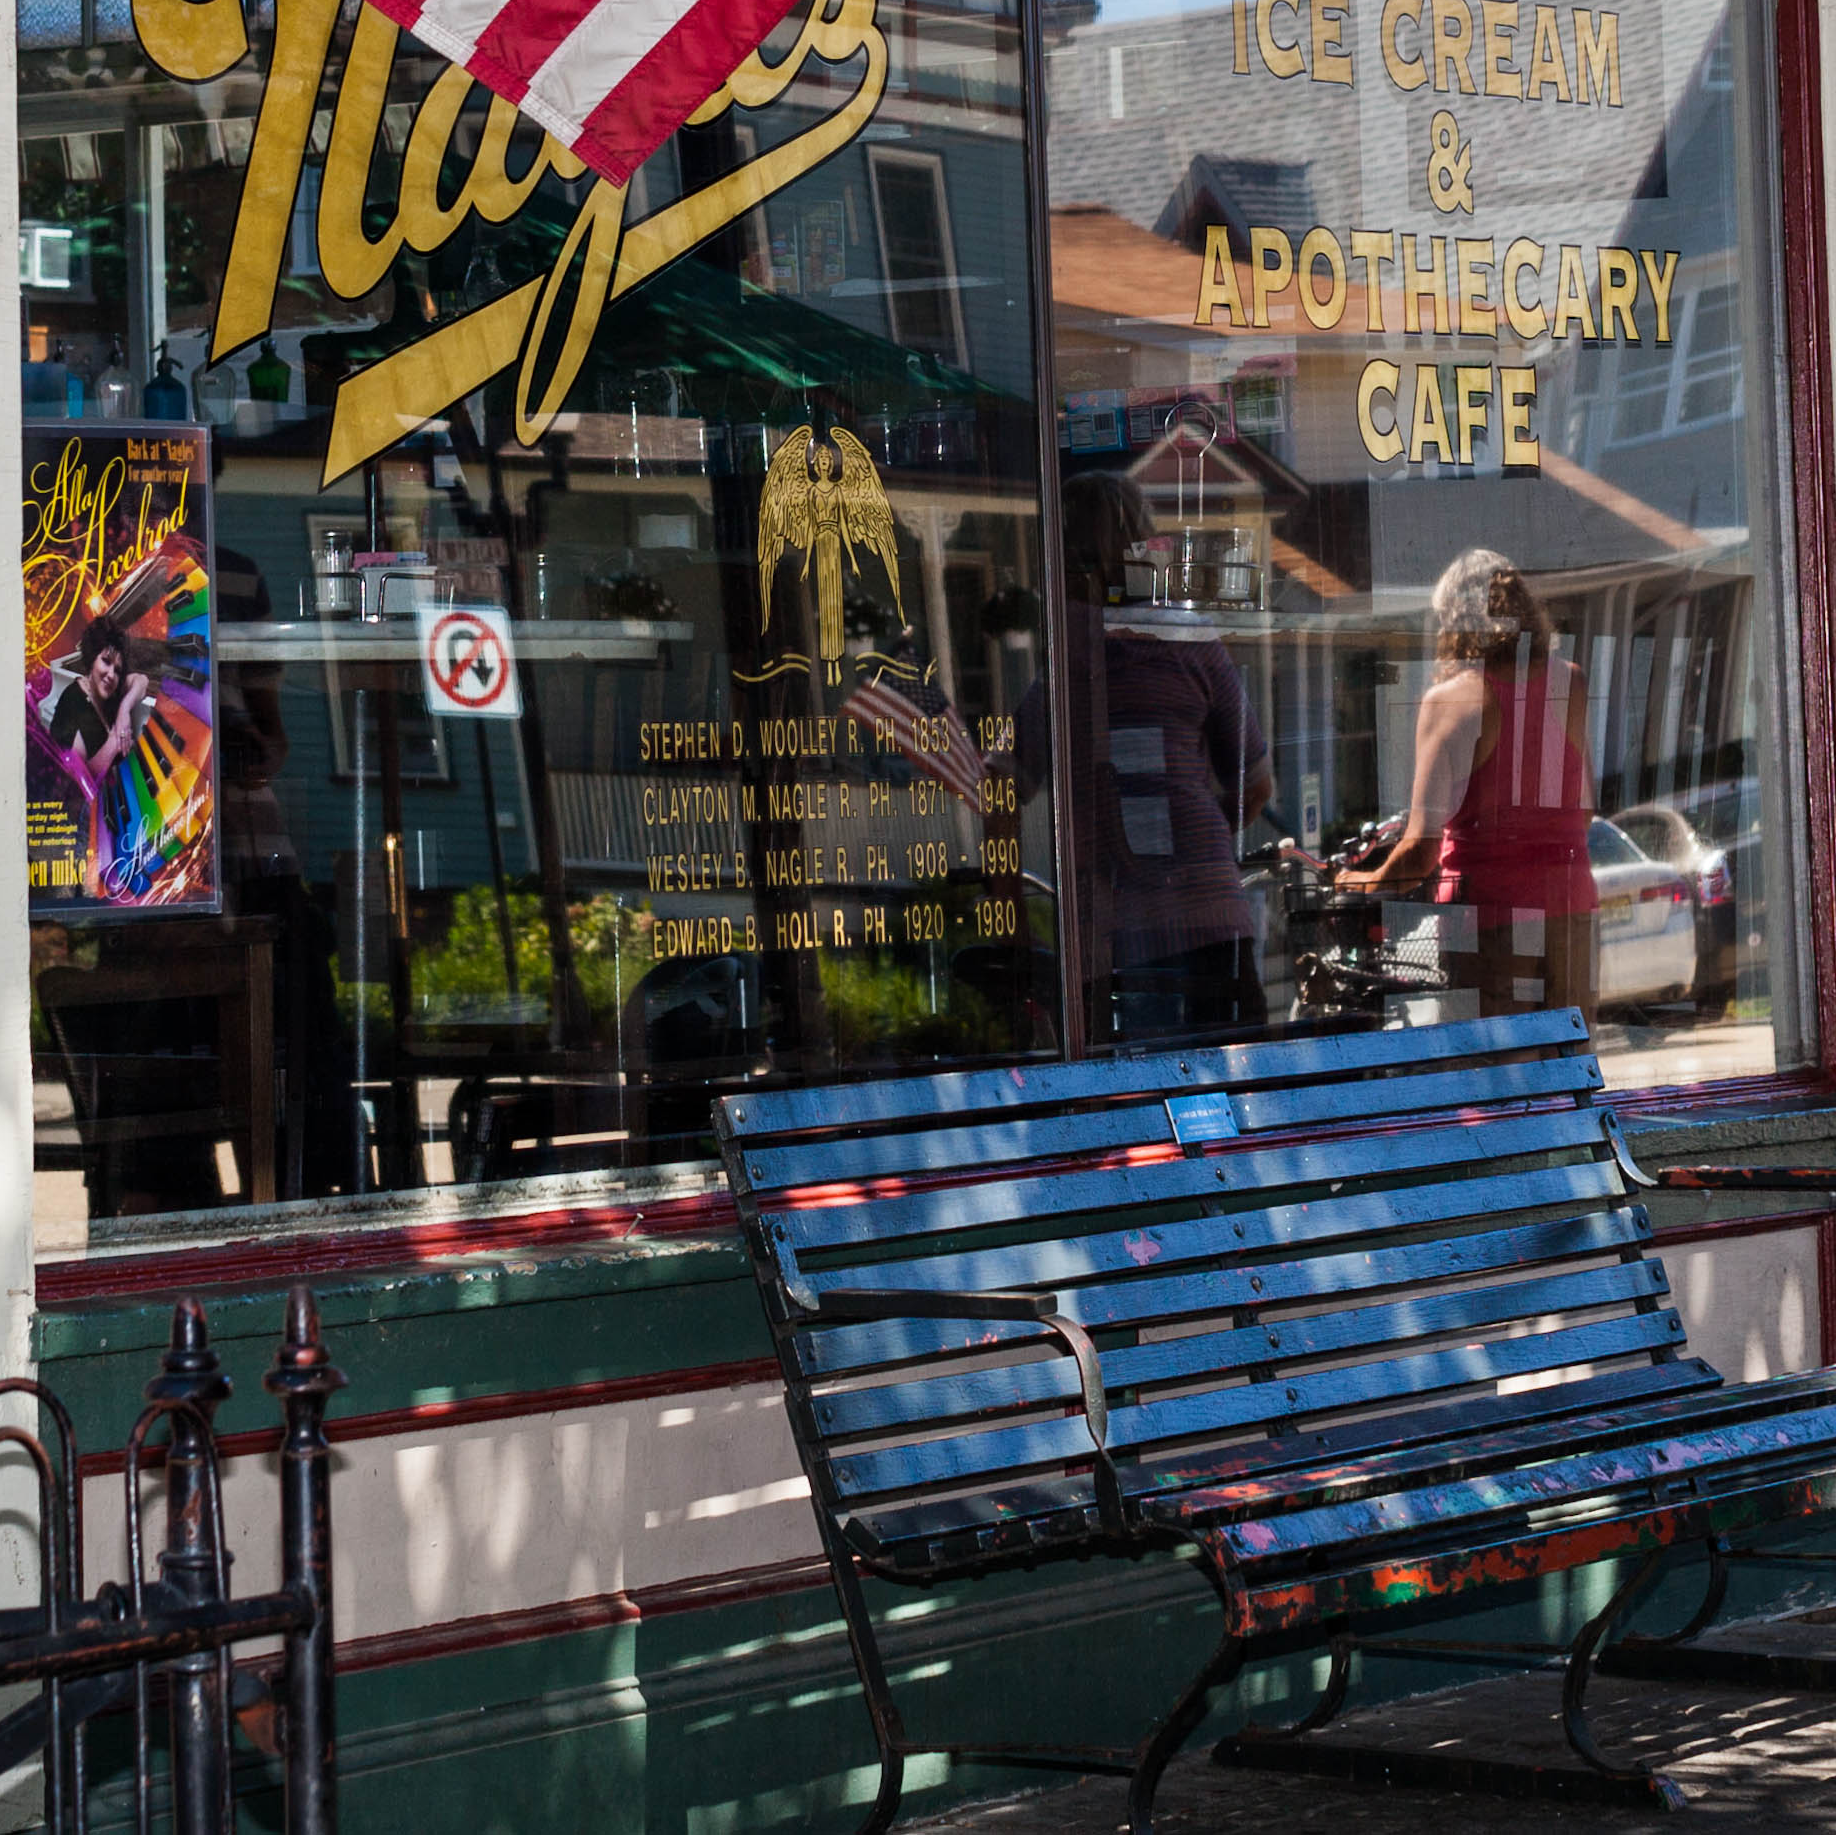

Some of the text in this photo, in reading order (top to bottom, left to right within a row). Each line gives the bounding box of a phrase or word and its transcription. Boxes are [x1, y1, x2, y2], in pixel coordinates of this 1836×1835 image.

[1426, 109, 1475, 215] &
[1193, 223, 1682, 344] APOTHECARY
[1356, 358, 1541, 469] CAFE
[127, 437, 149, 460] Back
[150, 439, 161, 461] at
[47, 455, 190, 620] Axelrod
[639, 719, 721, 764] STEPHEN
[732, 718, 751, 759] D.
[759, 716, 839, 758] WOOLLEY
[847, 716, 865, 754] R.
[874, 716, 902, 754] PH.
[911, 715, 951, 754] 1853
[977, 715, 1016, 754] 1939
[643, 785, 730, 827] CLAYTON
[741, 784, 762, 823] M.
[767, 781, 828, 822] NAGLE
[838, 782, 858, 819] R.
[868, 780, 899, 819] PH.
[908, 779, 946, 818] 1871
[975, 776, 1017, 815] 1946
[646, 851, 724, 893] WESLEY
[735, 850, 754, 890] B.
[765, 846, 825, 888] NAGLE
[836, 845, 855, 883] R.
[866, 843, 896, 882] PH.
[905, 841, 948, 879] 1908
[978, 837, 1020, 876] 1990
[652, 916, 733, 960] EDWARD
[744, 913, 765, 953] B.
[775, 908, 823, 951] HOLL
[833, 908, 853, 949] R.
[863, 905, 893, 946] PH.
[903, 903, 945, 943] 1920
[973, 899, 1017, 938] 1980
